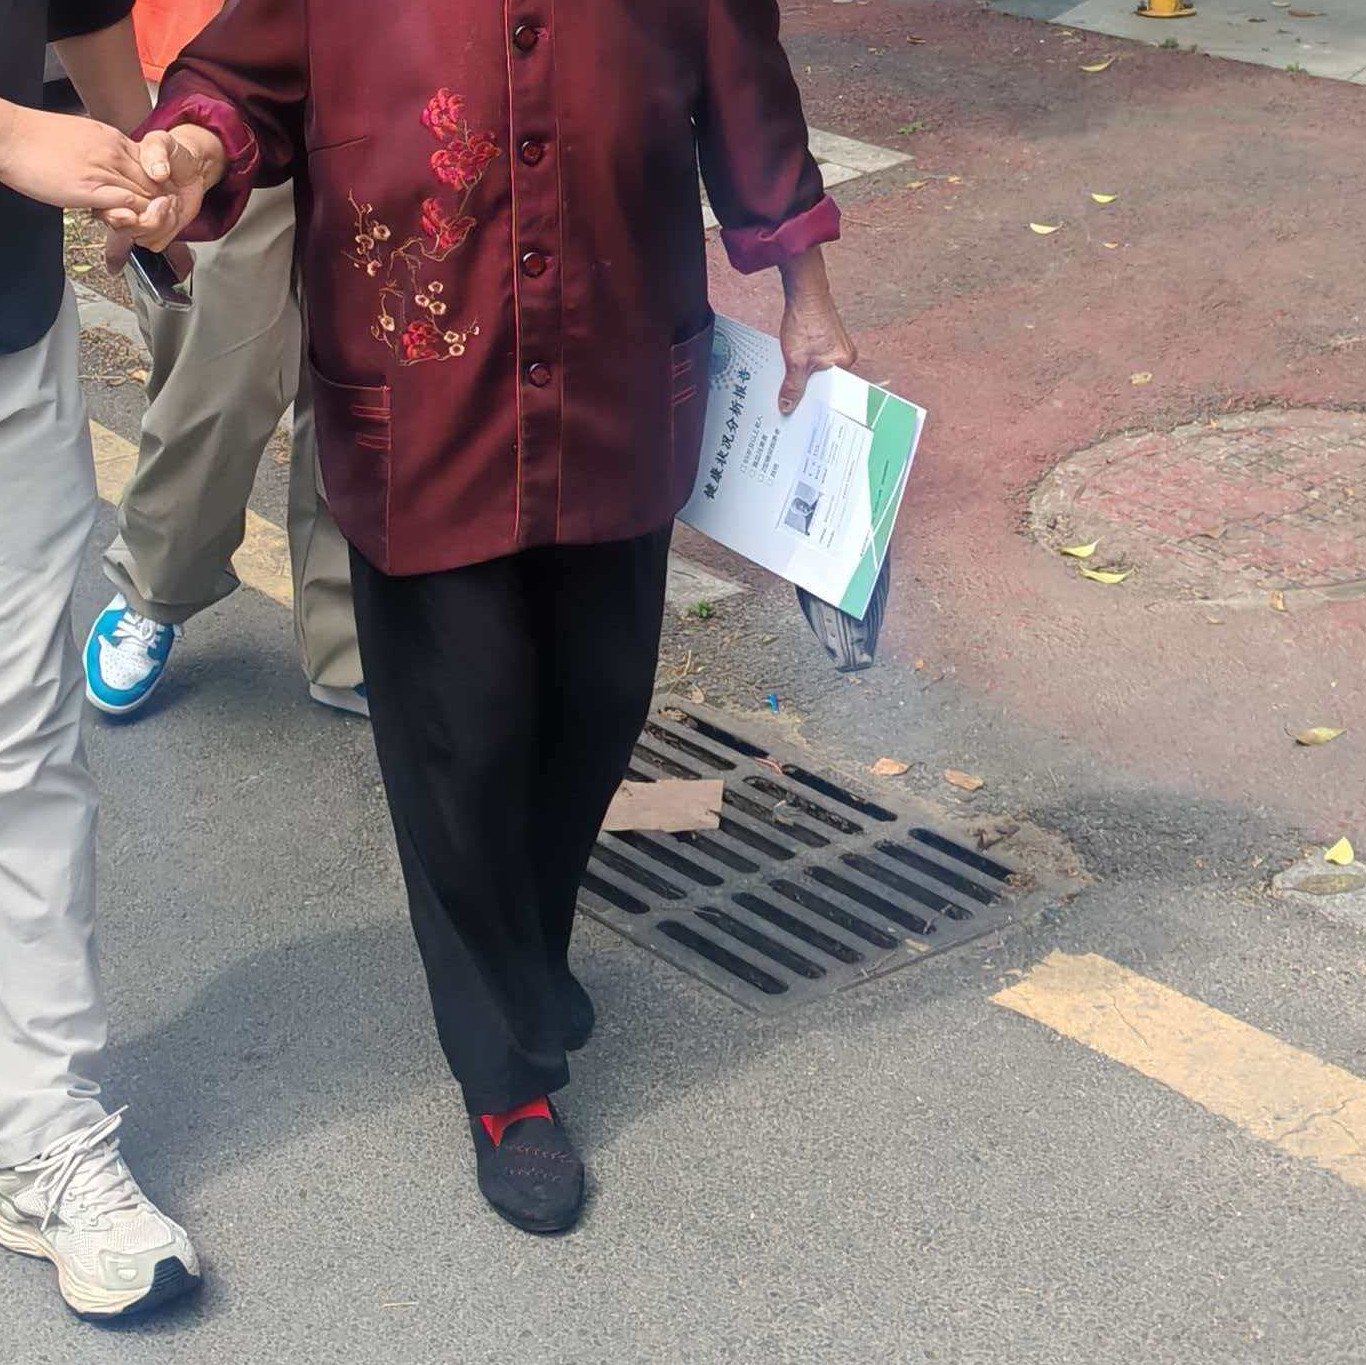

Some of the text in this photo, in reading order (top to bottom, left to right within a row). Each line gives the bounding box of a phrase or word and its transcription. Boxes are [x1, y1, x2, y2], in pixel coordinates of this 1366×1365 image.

[703, 367, 751, 499] 健康状况分析报告
